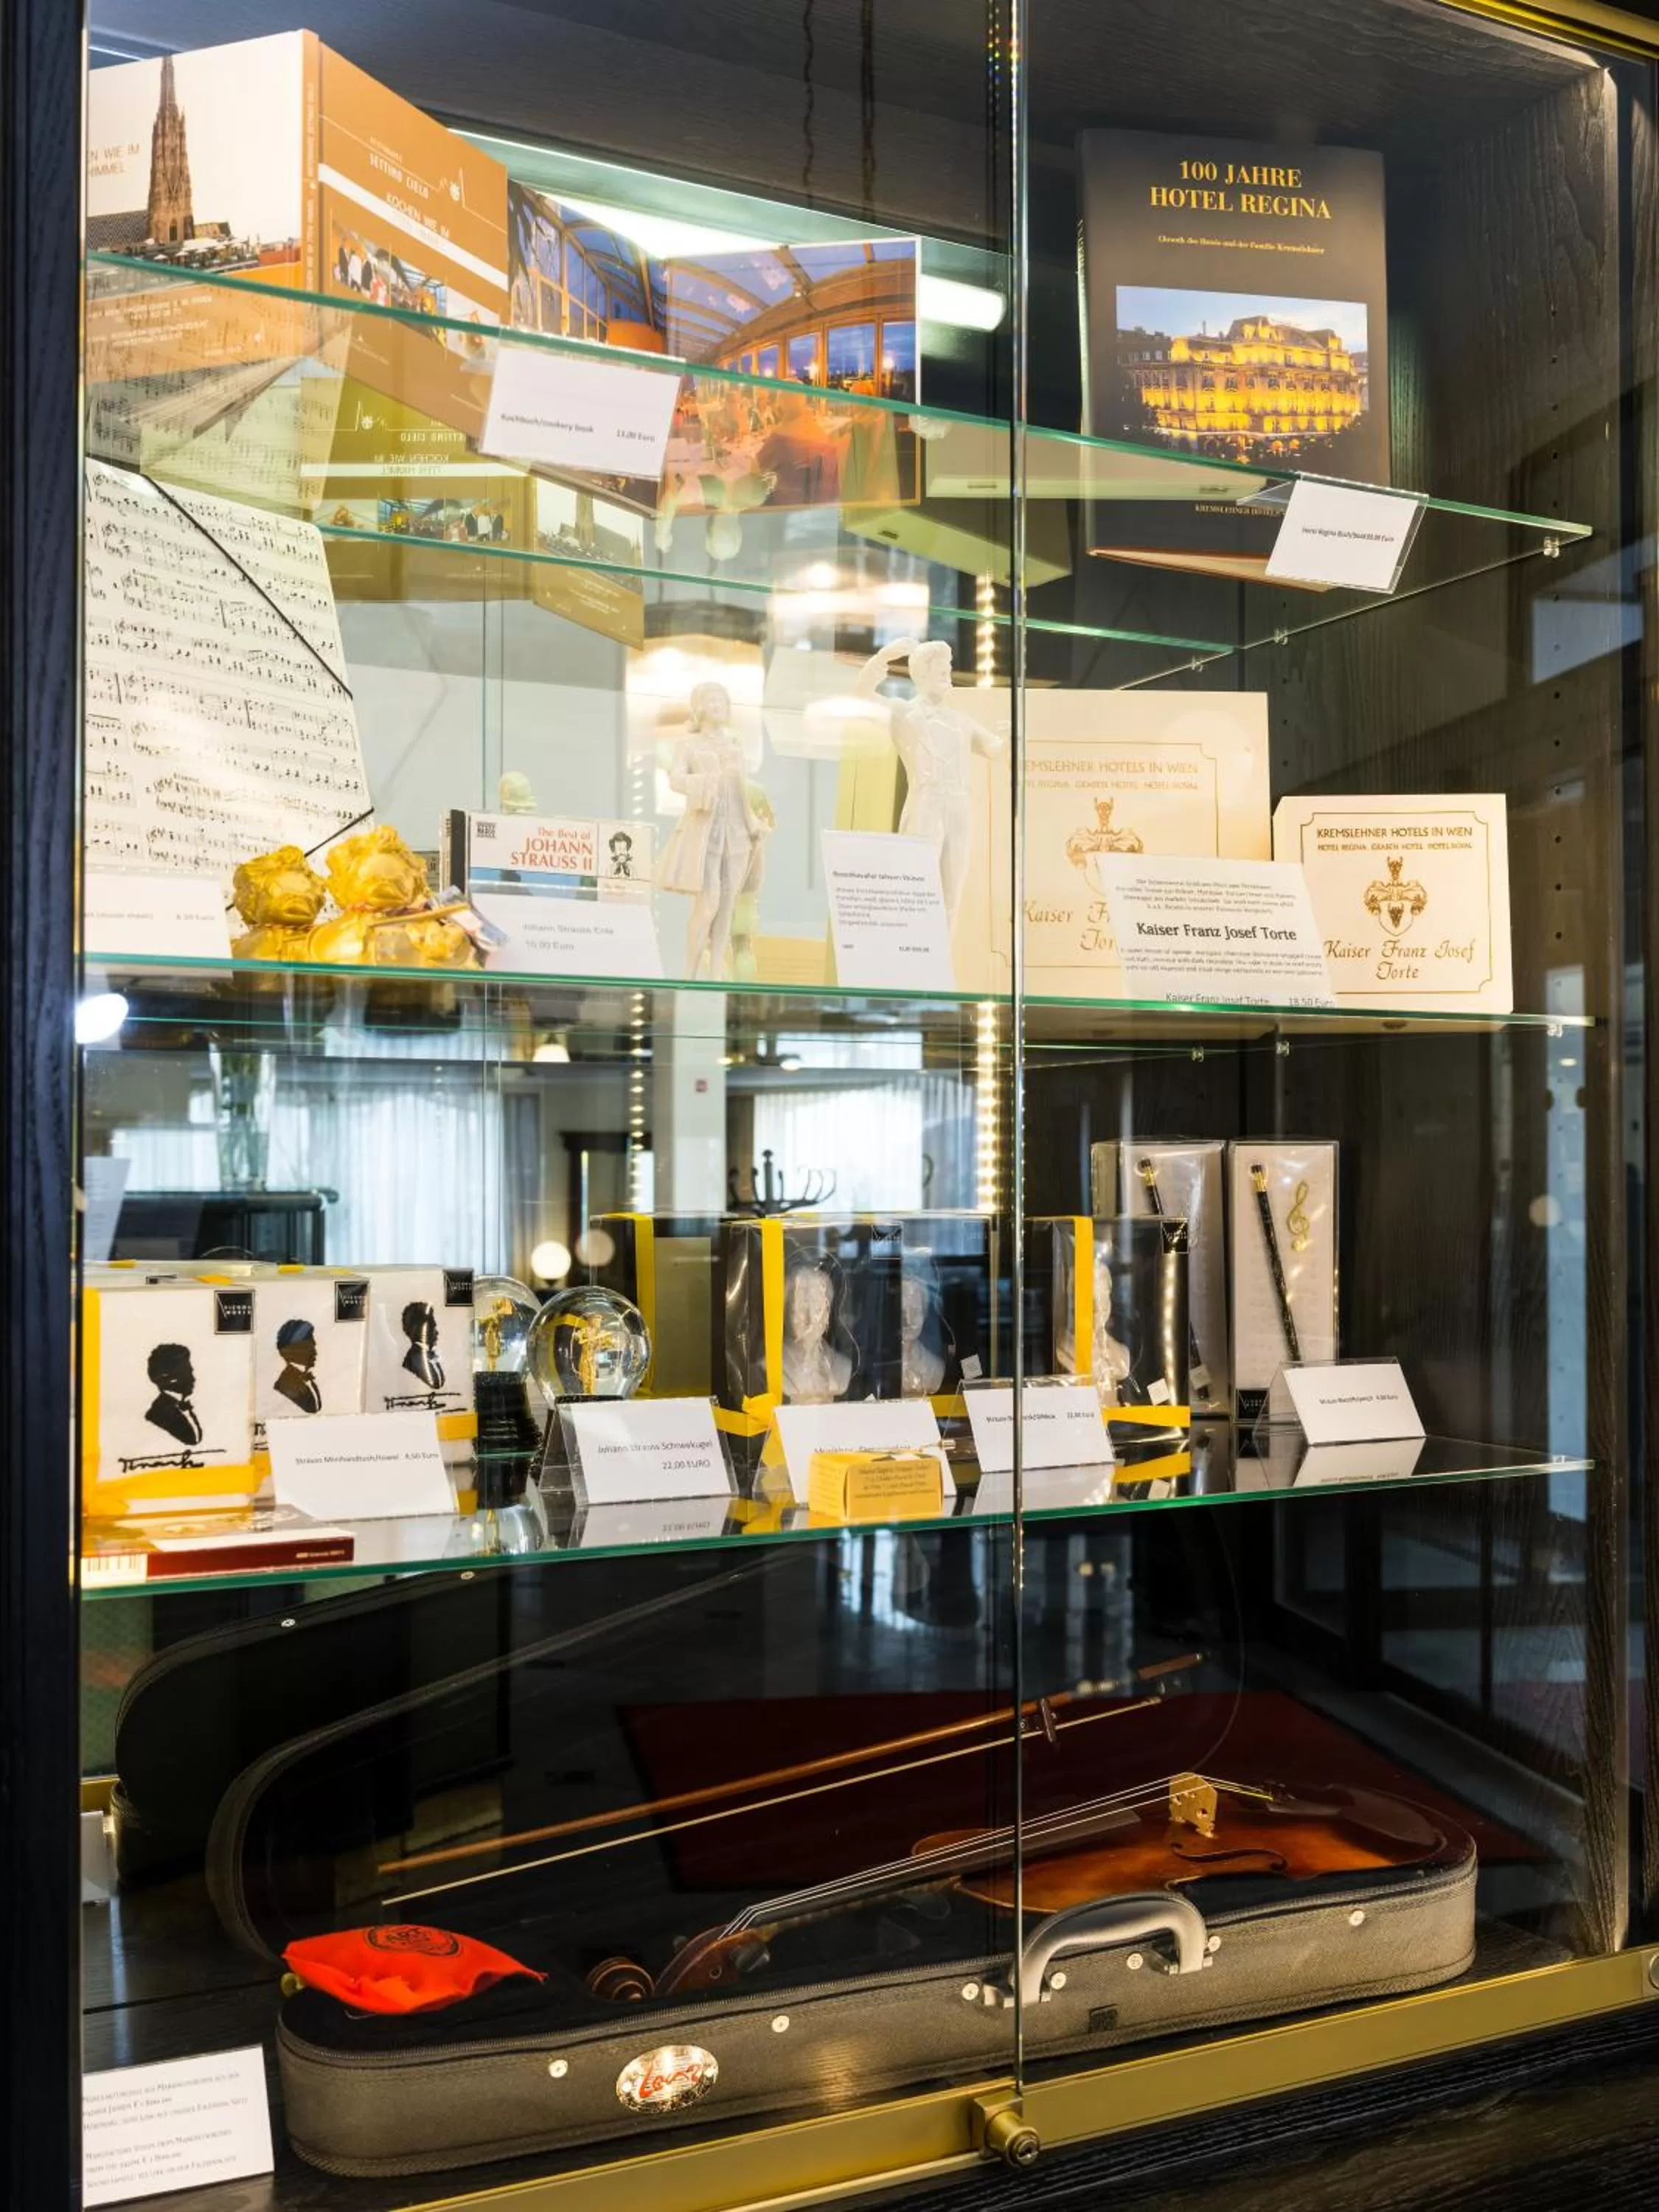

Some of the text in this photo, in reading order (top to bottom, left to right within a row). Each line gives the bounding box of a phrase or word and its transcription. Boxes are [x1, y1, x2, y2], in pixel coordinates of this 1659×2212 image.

[127, 142, 140, 156] IM
[1179, 160, 1303, 189] 100 JAHRE
[1150, 186, 1332, 219] HOTEL REGINA
[638, 434, 655, 442] Euro
[1023, 760, 1199, 773] EMSLEHNER HOTELS IN WIEN
[538, 827, 591, 840] The Best of
[1317, 827, 1472, 838] KREMSLEHNER HOTELS IN WIEN
[525, 837, 594, 855] JOHANN
[510, 852, 593, 871] STRAUSS II
[1081, 928, 1116, 951] Tor
[1136, 922, 1297, 941] Kaiser Franz Josef Torte
[1324, 938, 1477, 963] Kaiser Franz Josef
[1376, 961, 1422, 980] Torte
[1166, 992, 1193, 1003] Kaiser
[1196, 994, 1218, 1004] Franz
[1245, 996, 1270, 1005] Torte
[661, 1439, 713, 1451] Schneekugel
